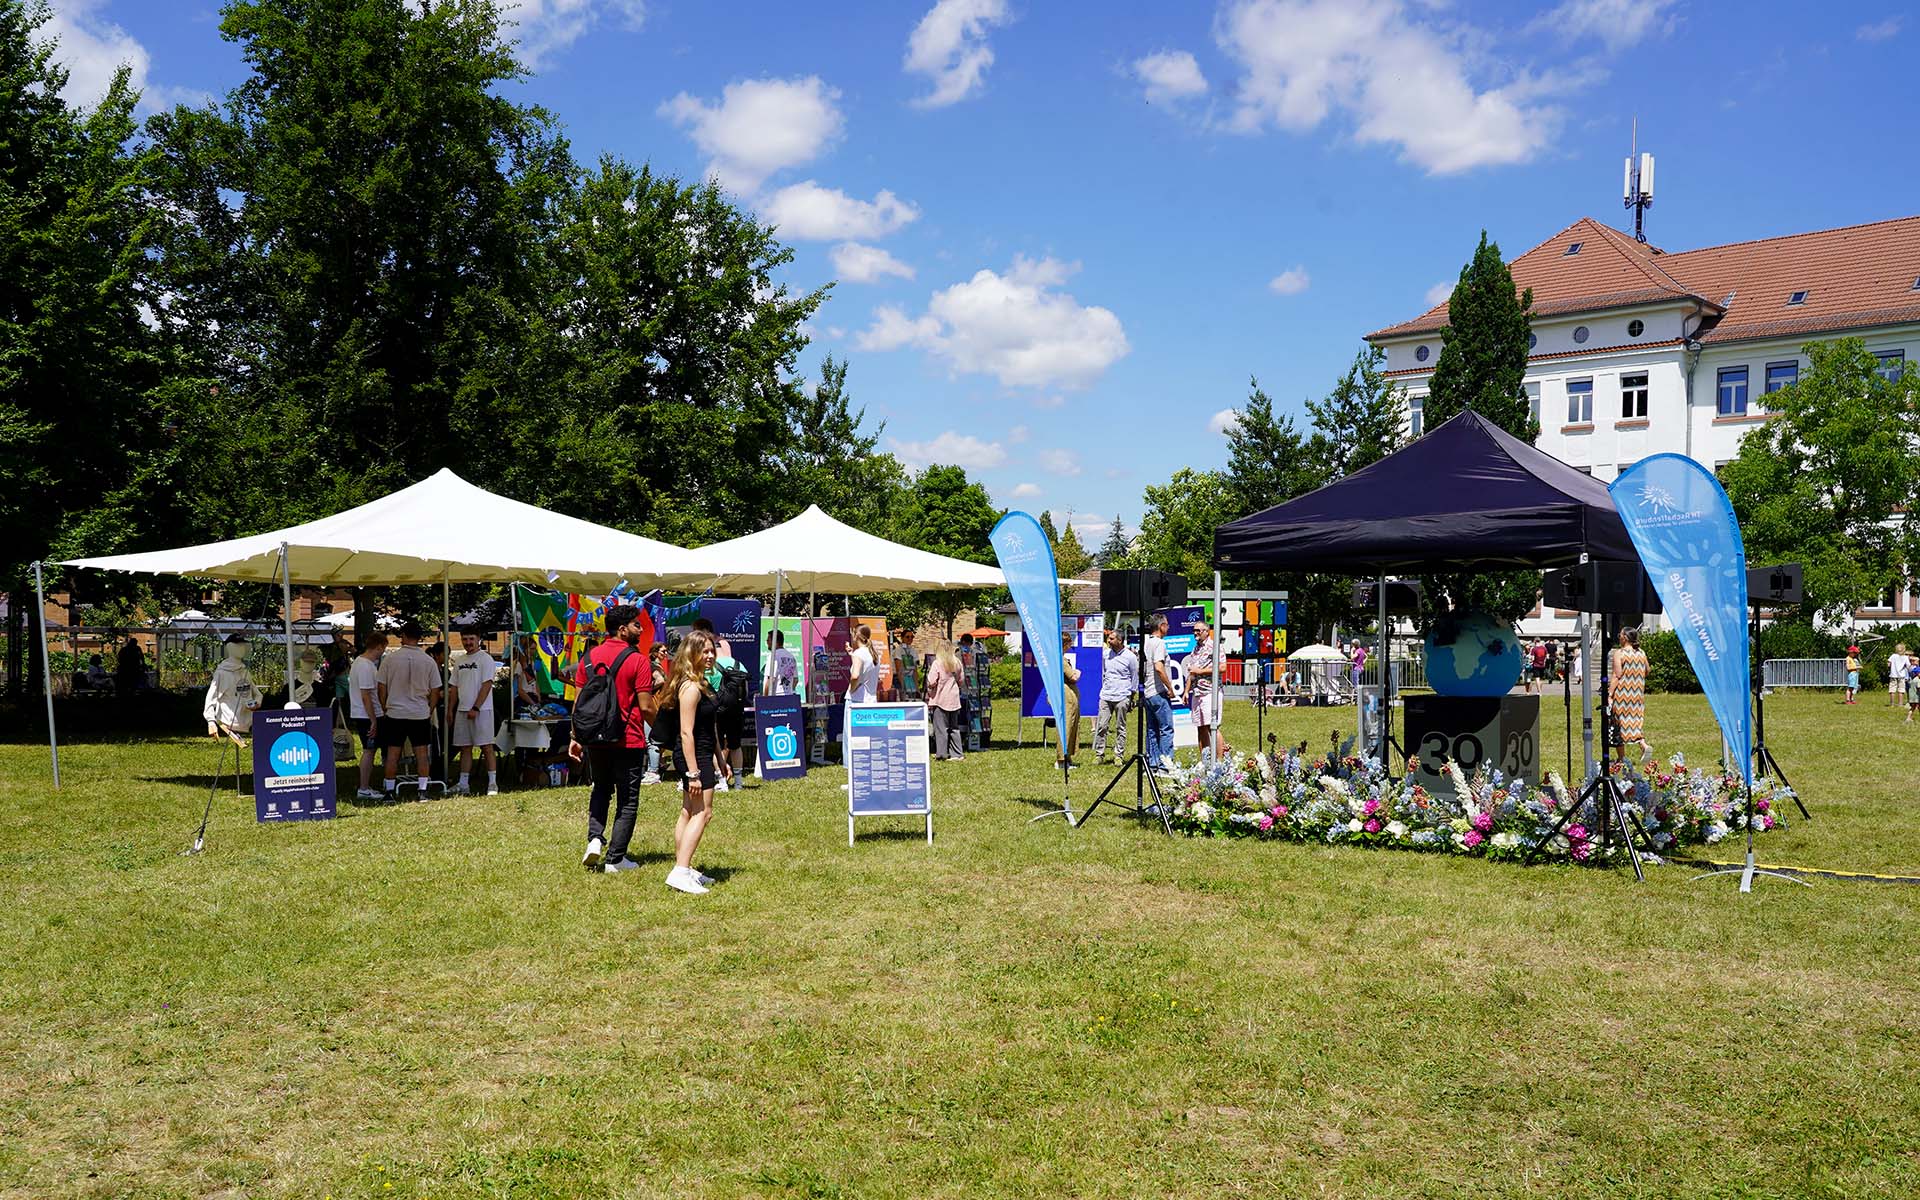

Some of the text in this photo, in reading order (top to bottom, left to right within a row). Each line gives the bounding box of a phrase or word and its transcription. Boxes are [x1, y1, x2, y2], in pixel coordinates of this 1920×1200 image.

[855, 712, 899, 721] Open Campus
[1420, 732, 1484, 777] 30
[1507, 731, 1533, 778] 30
